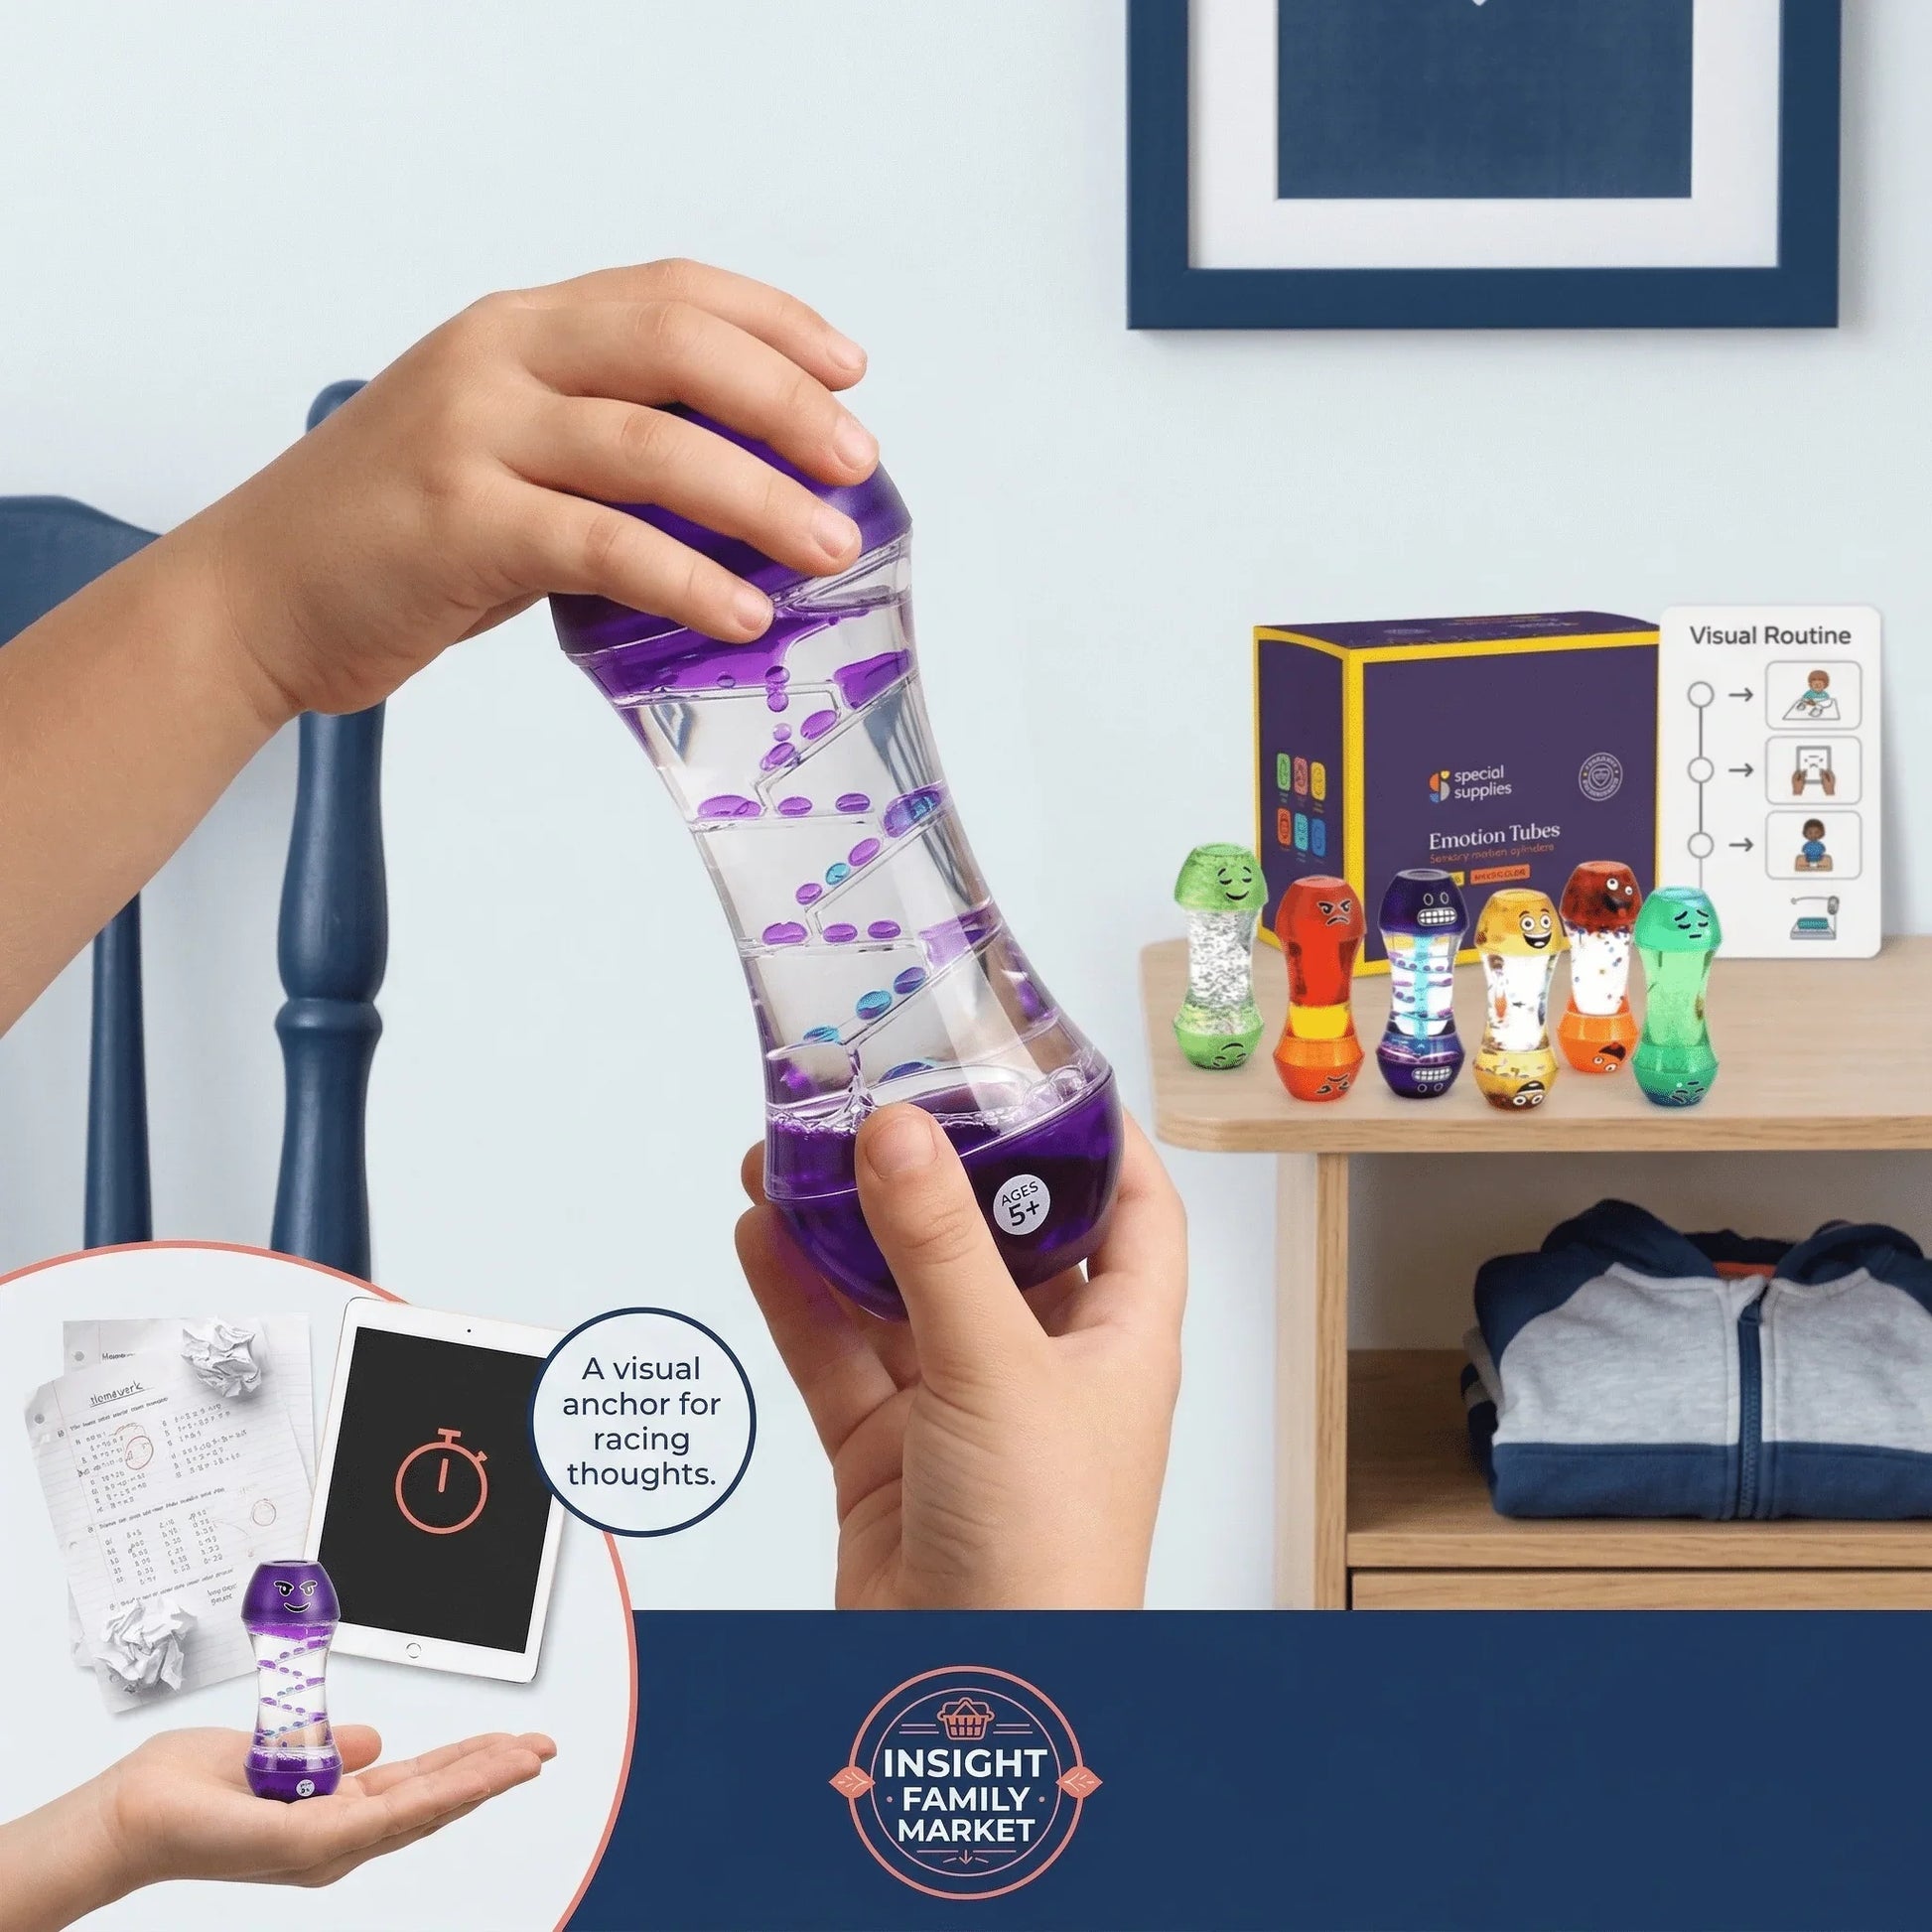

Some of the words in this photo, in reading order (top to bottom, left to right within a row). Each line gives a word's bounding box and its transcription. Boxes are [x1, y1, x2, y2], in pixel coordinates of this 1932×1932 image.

[1690, 624, 1756, 645] Visual
[1764, 624, 1852, 645] Routine
[1454, 764, 1504, 785] special
[1454, 781, 1512, 801] supplies
[1429, 828, 1505, 851] Emotion
[1509, 822, 1561, 842] Tubes
[1002, 1180, 1038, 1206] AGES
[1009, 1200, 1039, 1227] 5+
